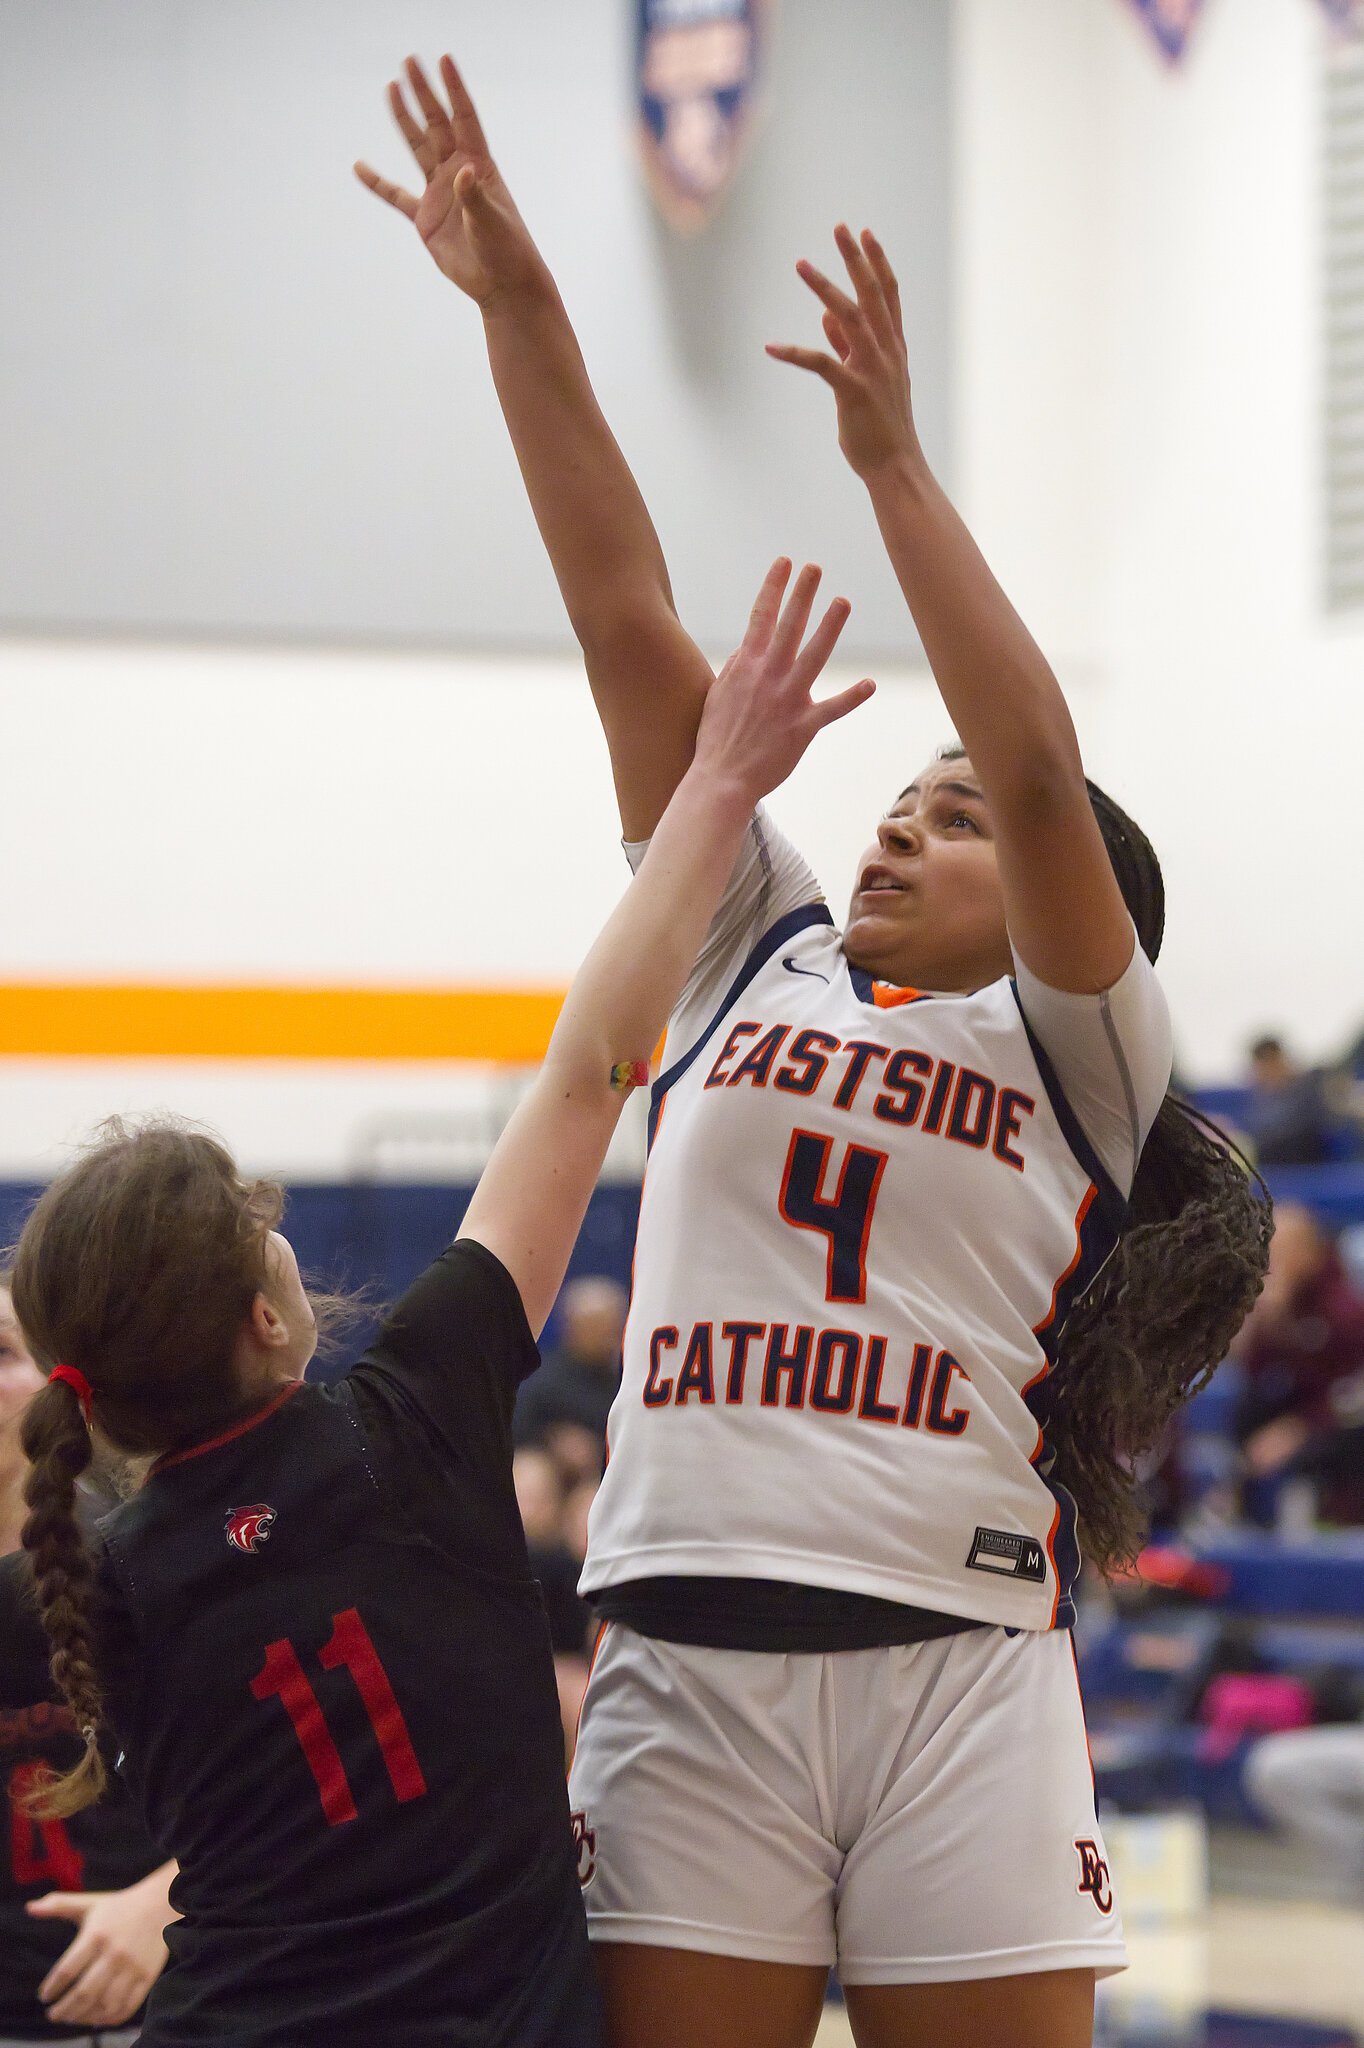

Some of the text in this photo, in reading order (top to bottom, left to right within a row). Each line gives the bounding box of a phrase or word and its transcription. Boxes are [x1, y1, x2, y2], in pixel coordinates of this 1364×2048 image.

[704, 1021, 1035, 1172] EASTSIDE
[778, 1127, 889, 1304] 4
[643, 1321, 971, 1436] CATHOLIC
[1027, 1551, 1039, 1569] M
[250, 1607, 427, 1826] 11
[1074, 1839, 1113, 1914] EC
